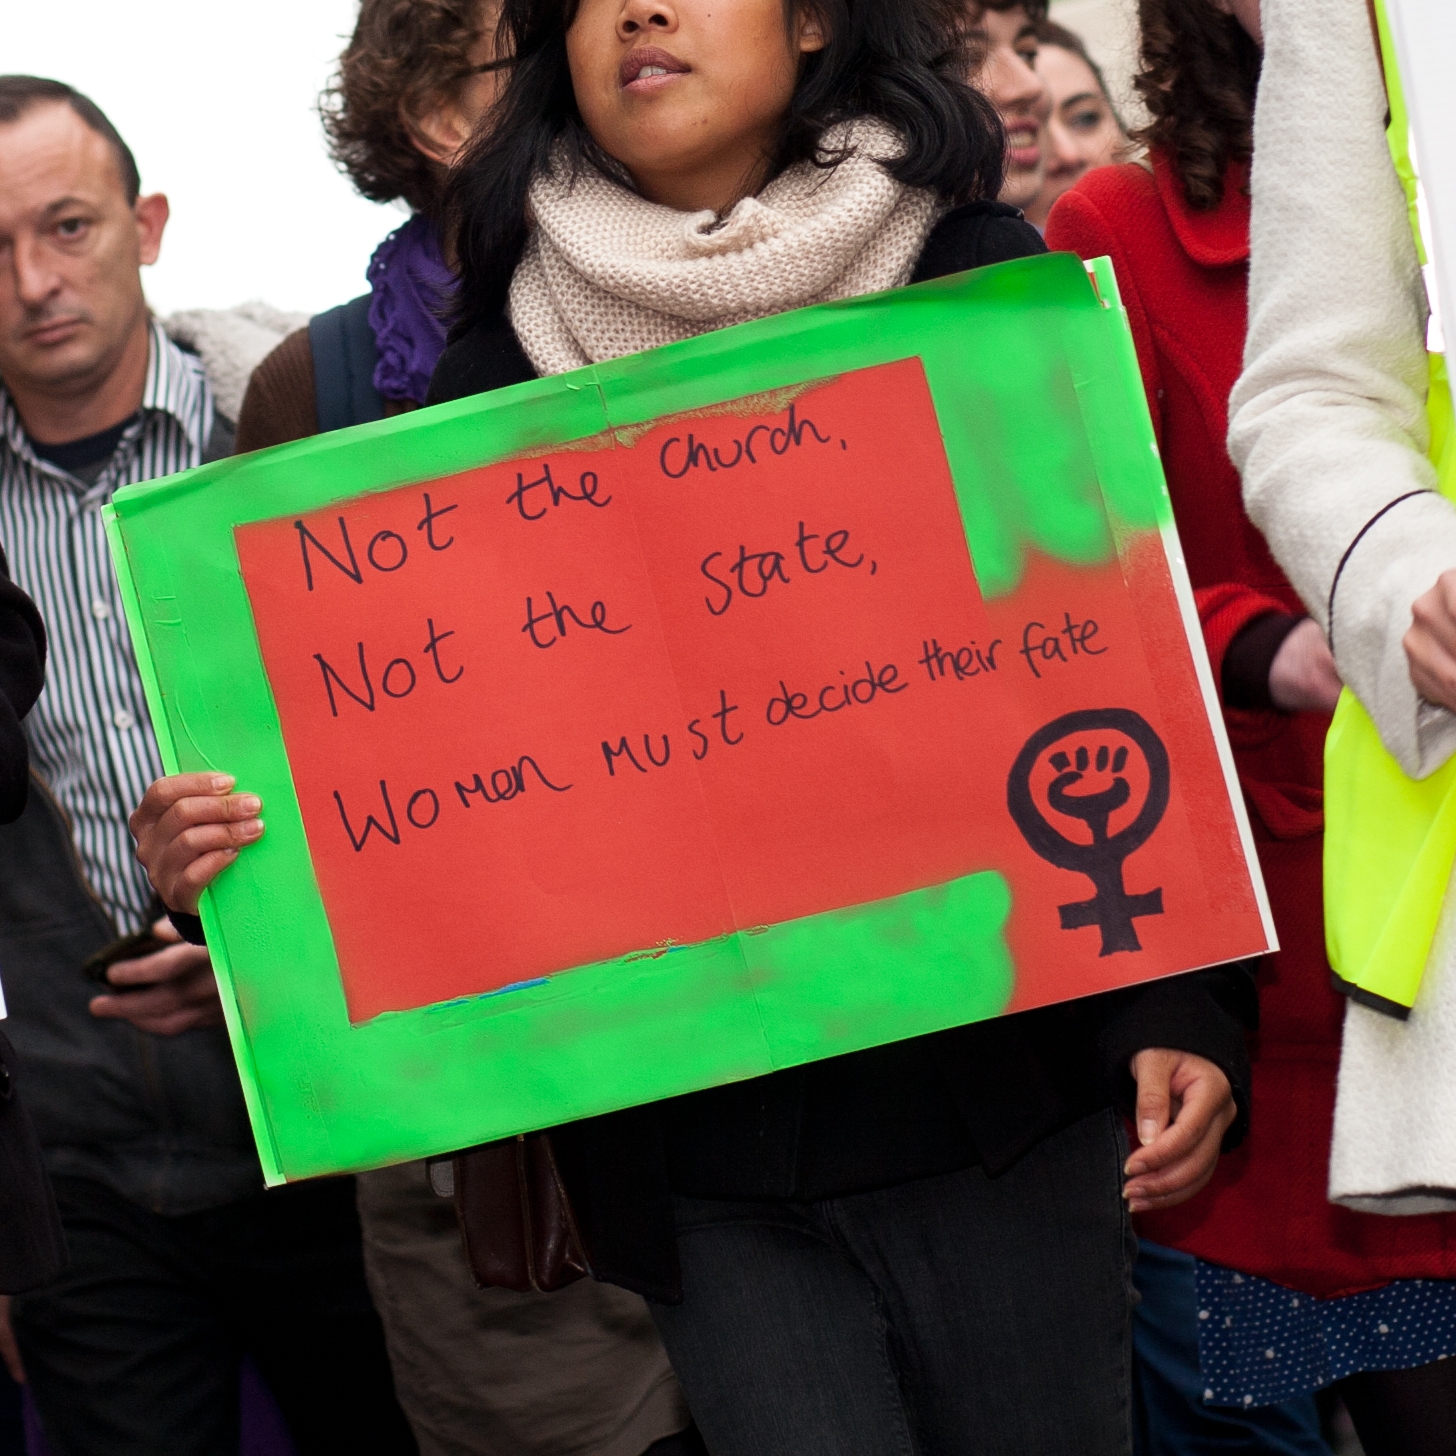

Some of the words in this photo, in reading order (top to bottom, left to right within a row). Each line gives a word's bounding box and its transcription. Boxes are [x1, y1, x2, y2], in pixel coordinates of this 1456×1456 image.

[294, 493, 457, 591] Not
[506, 464, 611, 520] the
[314, 619, 463, 717] Not
[522, 592, 629, 648] the
[767, 663, 907, 725] decide
[920, 640, 1000, 680] their
[1021, 614, 1105, 678] fate
